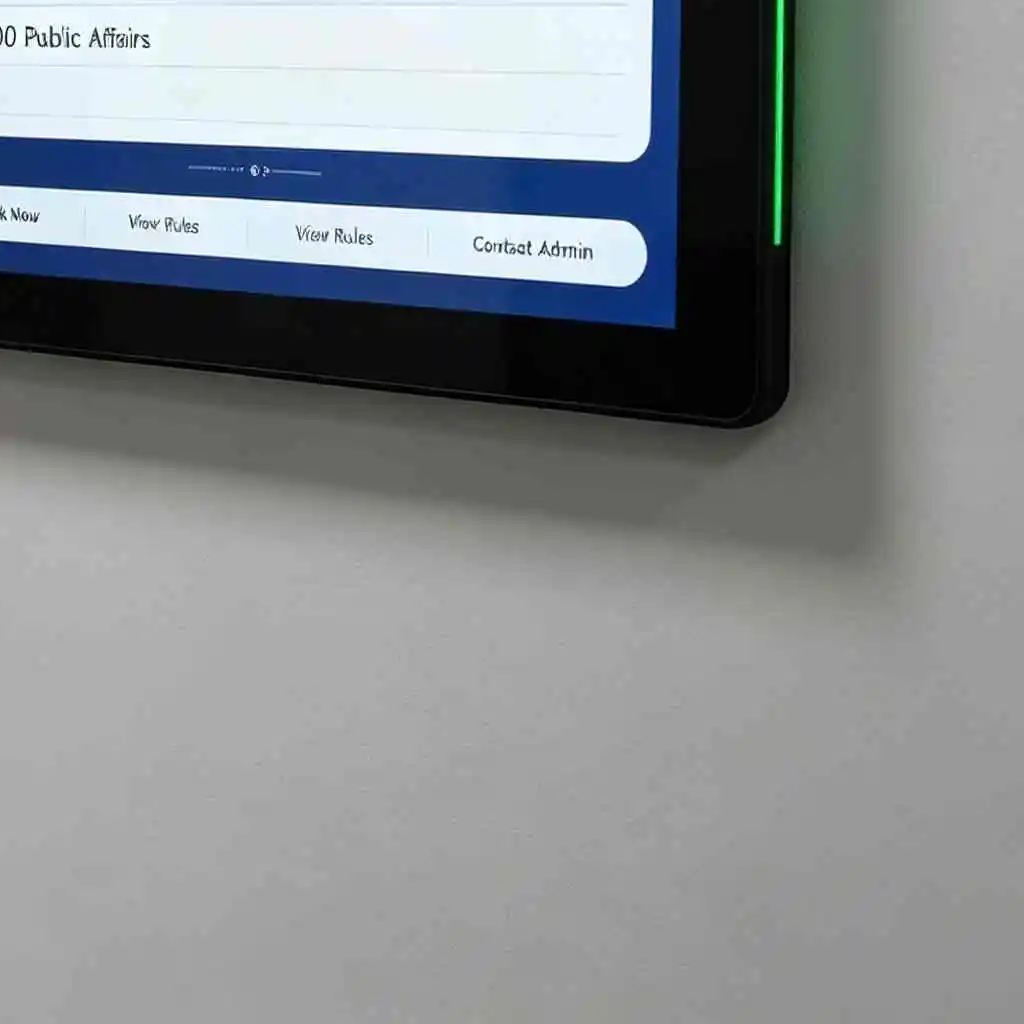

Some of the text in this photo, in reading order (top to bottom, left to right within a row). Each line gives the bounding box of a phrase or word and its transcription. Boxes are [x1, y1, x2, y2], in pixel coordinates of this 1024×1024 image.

[24, 25, 81, 49] Public
[88, 27, 151, 49] Affairs
[334, 227, 374, 246] Rules
[537, 239, 594, 261] Admin
